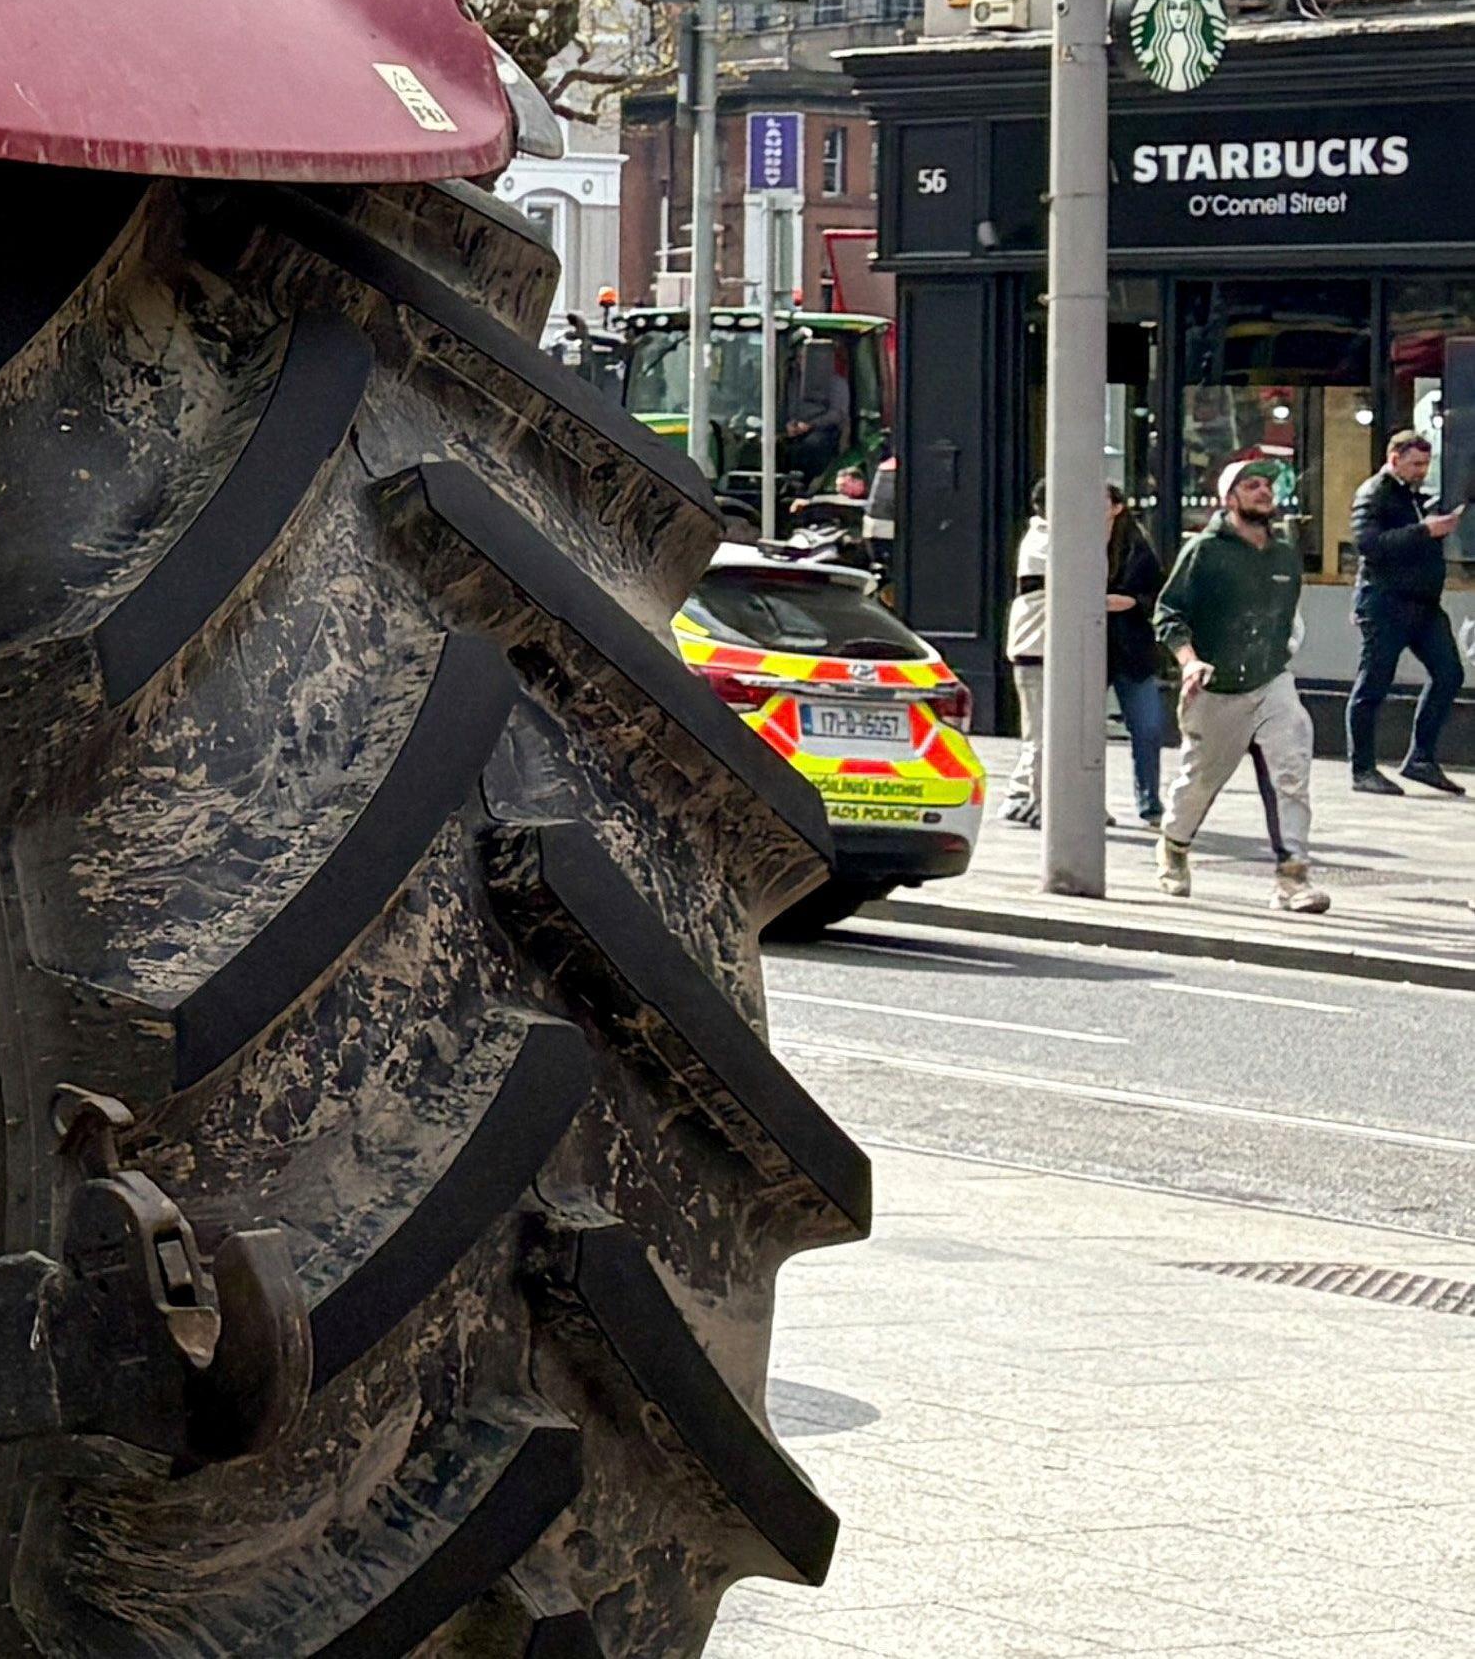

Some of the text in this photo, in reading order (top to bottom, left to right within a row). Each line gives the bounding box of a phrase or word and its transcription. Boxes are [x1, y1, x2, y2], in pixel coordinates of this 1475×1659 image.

[1132, 136, 1409, 183] STARBUCKS
[917, 168, 947, 194] 56
[1189, 191, 1348, 217] O'Connell Street
